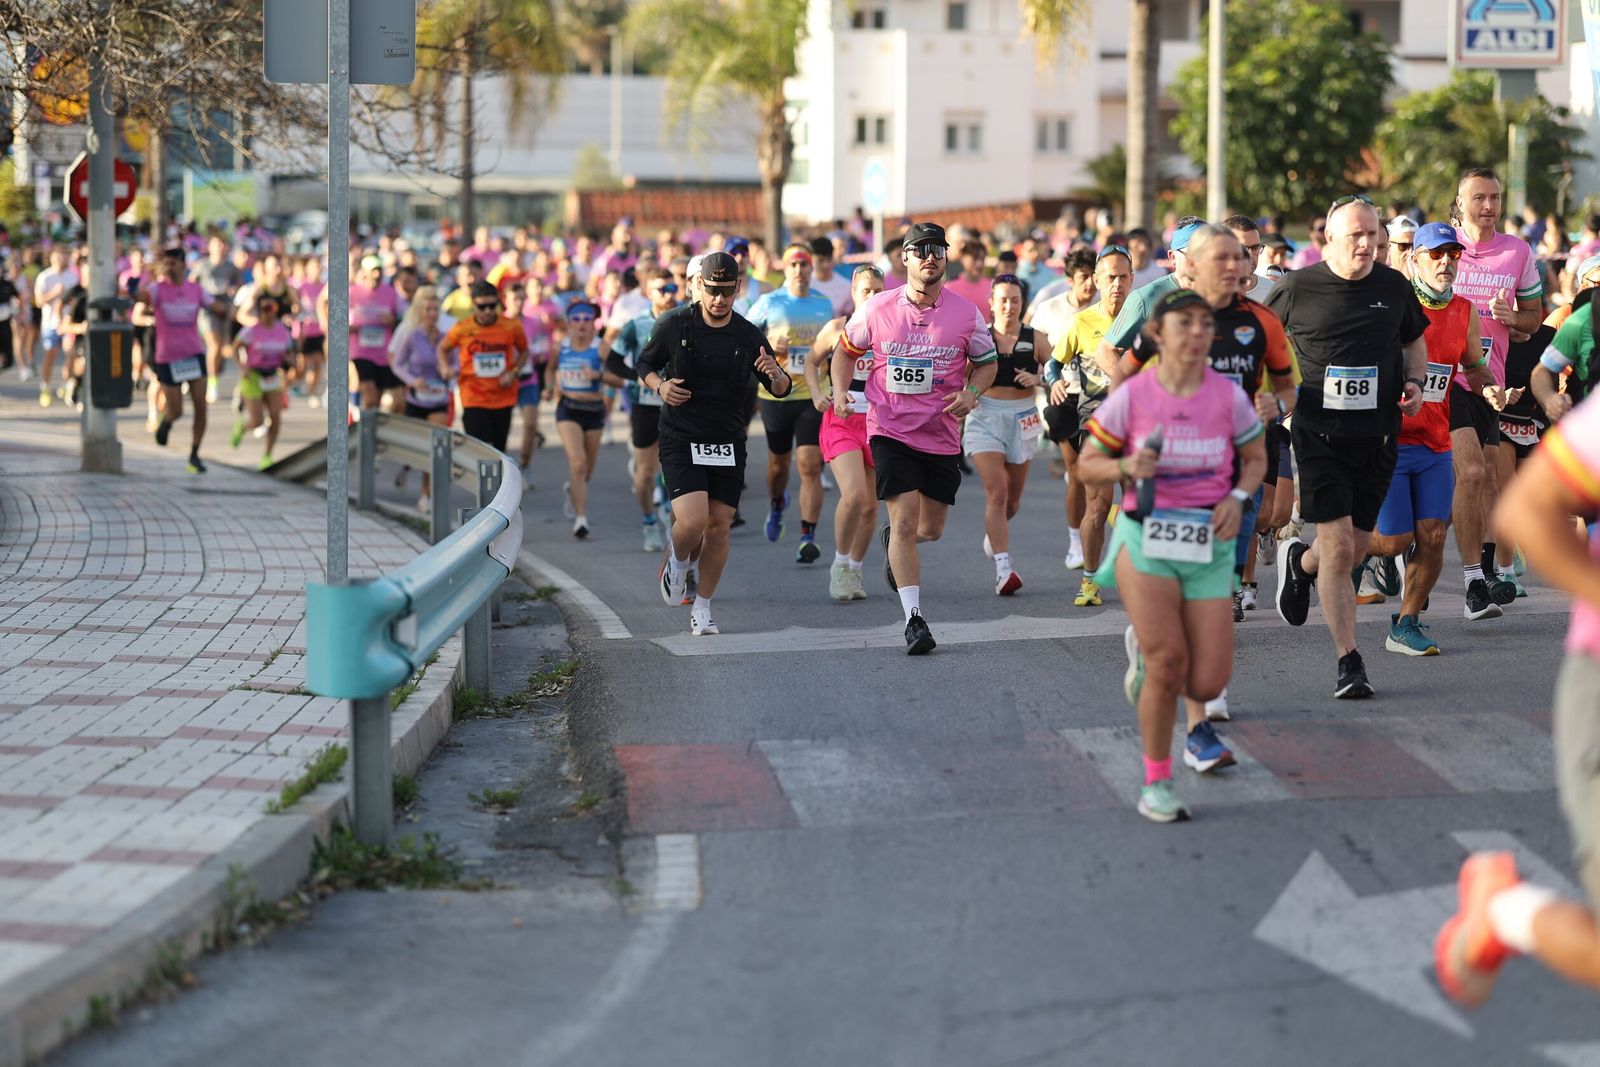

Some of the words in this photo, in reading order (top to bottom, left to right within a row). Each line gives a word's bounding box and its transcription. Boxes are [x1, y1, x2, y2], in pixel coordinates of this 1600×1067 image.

[1471, 29, 1547, 50] ALDI
[1464, 262, 1490, 273] XXXVI
[1468, 272, 1517, 289] MARATÓN
[906, 332, 934, 345] XXXVI
[893, 367, 925, 383] 365
[1334, 379, 1370, 396] 168
[1500, 422, 1536, 436] 2038
[694, 444, 732, 457] 1543
[1149, 521, 1209, 545] 2528
